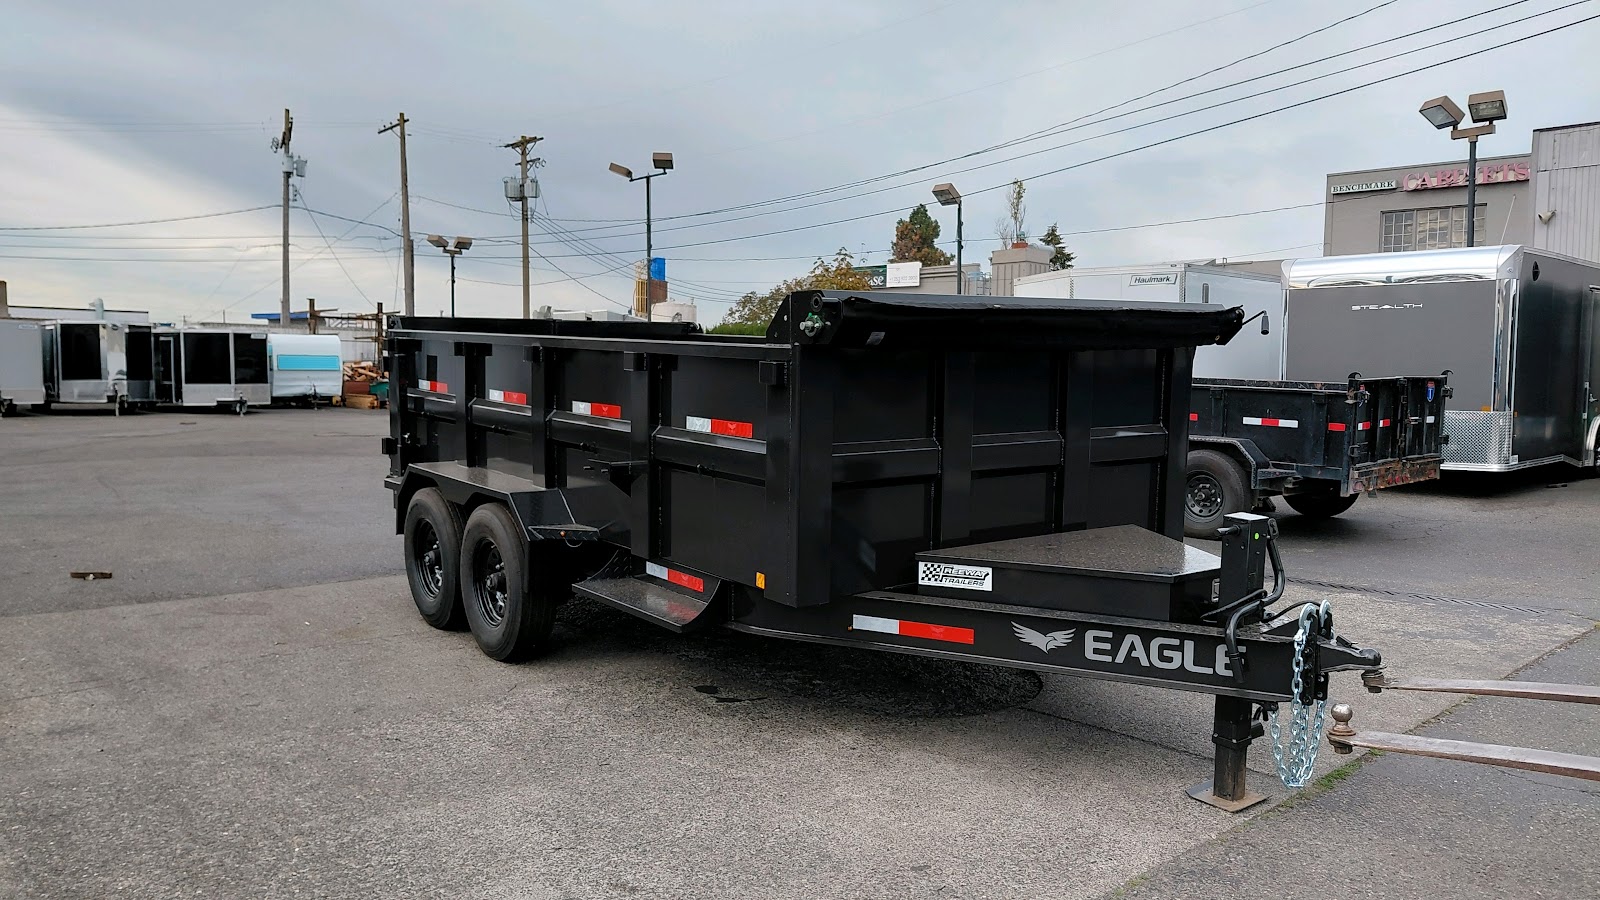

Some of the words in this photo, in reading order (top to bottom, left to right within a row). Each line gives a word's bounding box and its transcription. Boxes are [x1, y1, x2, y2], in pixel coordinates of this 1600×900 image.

[1332, 180, 1395, 193] BENCHMARK
[1134, 275, 1171, 284] Haulmark
[944, 577, 985, 587] TRAILERS
[1084, 629, 1247, 678] EAGLE
